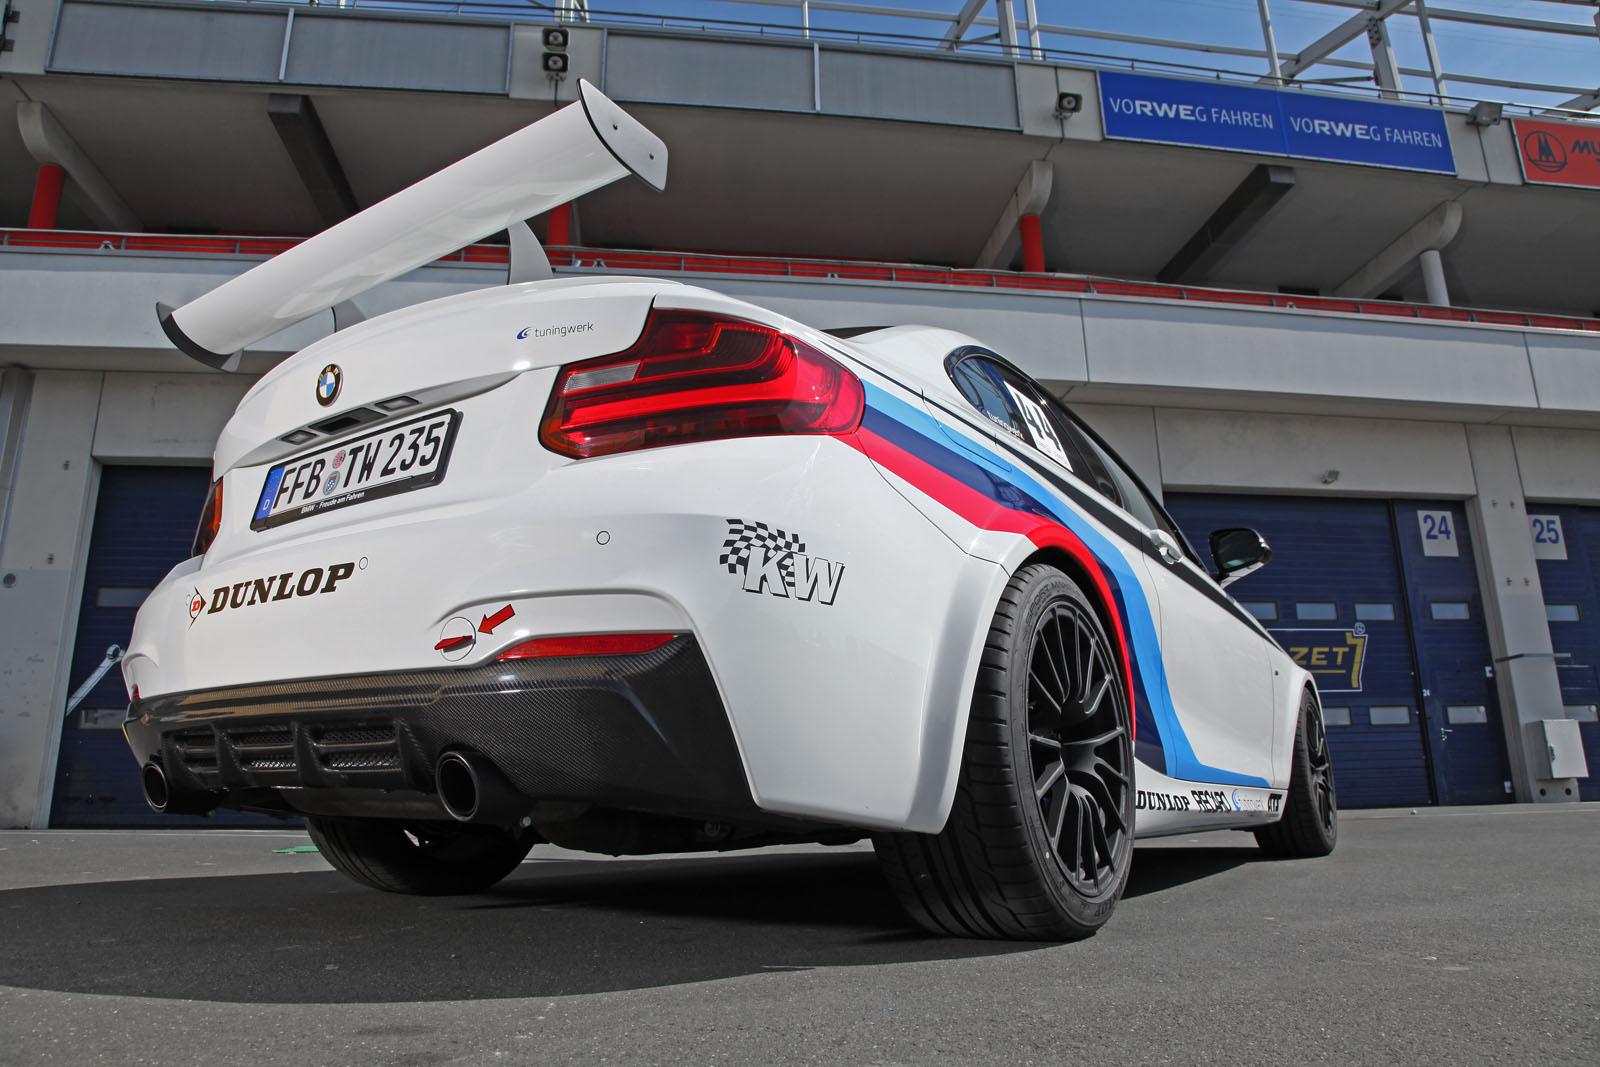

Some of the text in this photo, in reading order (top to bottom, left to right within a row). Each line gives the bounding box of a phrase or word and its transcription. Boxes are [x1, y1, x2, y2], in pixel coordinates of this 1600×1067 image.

[1109, 98, 1274, 129] VORWEG FAHREN
[1289, 116, 1443, 149] VORWEG FAHREN
[535, 322, 594, 337] tuningwerk
[273, 421, 445, 509] FFB TW 235
[262, 499, 270, 511] D
[301, 504, 316, 513] BMW
[319, 499, 337, 509] Freude
[346, 491, 365, 501] Fahren
[1423, 514, 1451, 540] 24
[1532, 518, 1560, 544] 25
[207, 562, 355, 615] DUNLOP
[742, 545, 846, 606] KW
[1136, 790, 1191, 811] DUNLOP
